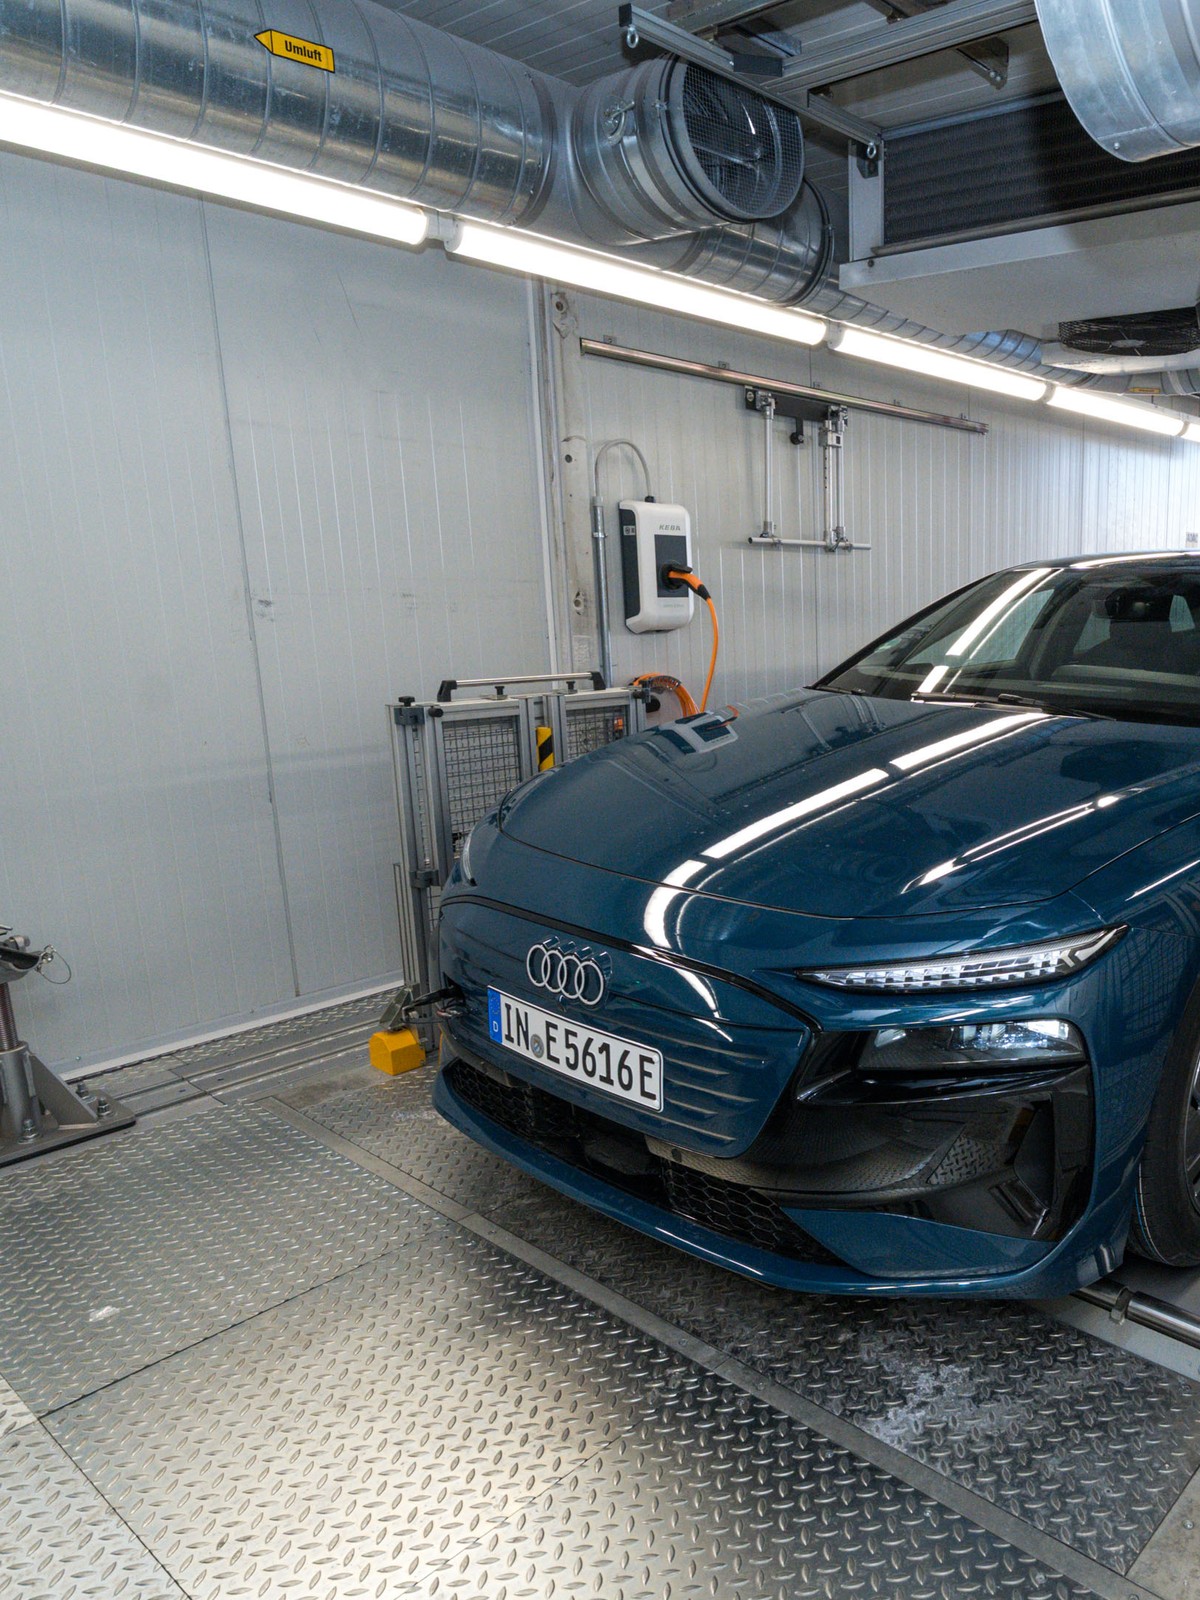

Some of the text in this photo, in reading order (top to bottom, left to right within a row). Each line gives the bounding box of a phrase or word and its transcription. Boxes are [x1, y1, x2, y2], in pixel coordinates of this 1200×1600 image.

[284, 40, 322, 62] Umluft
[492, 1020, 499, 1033] D
[504, 1002, 657, 1101] IN E5616E
